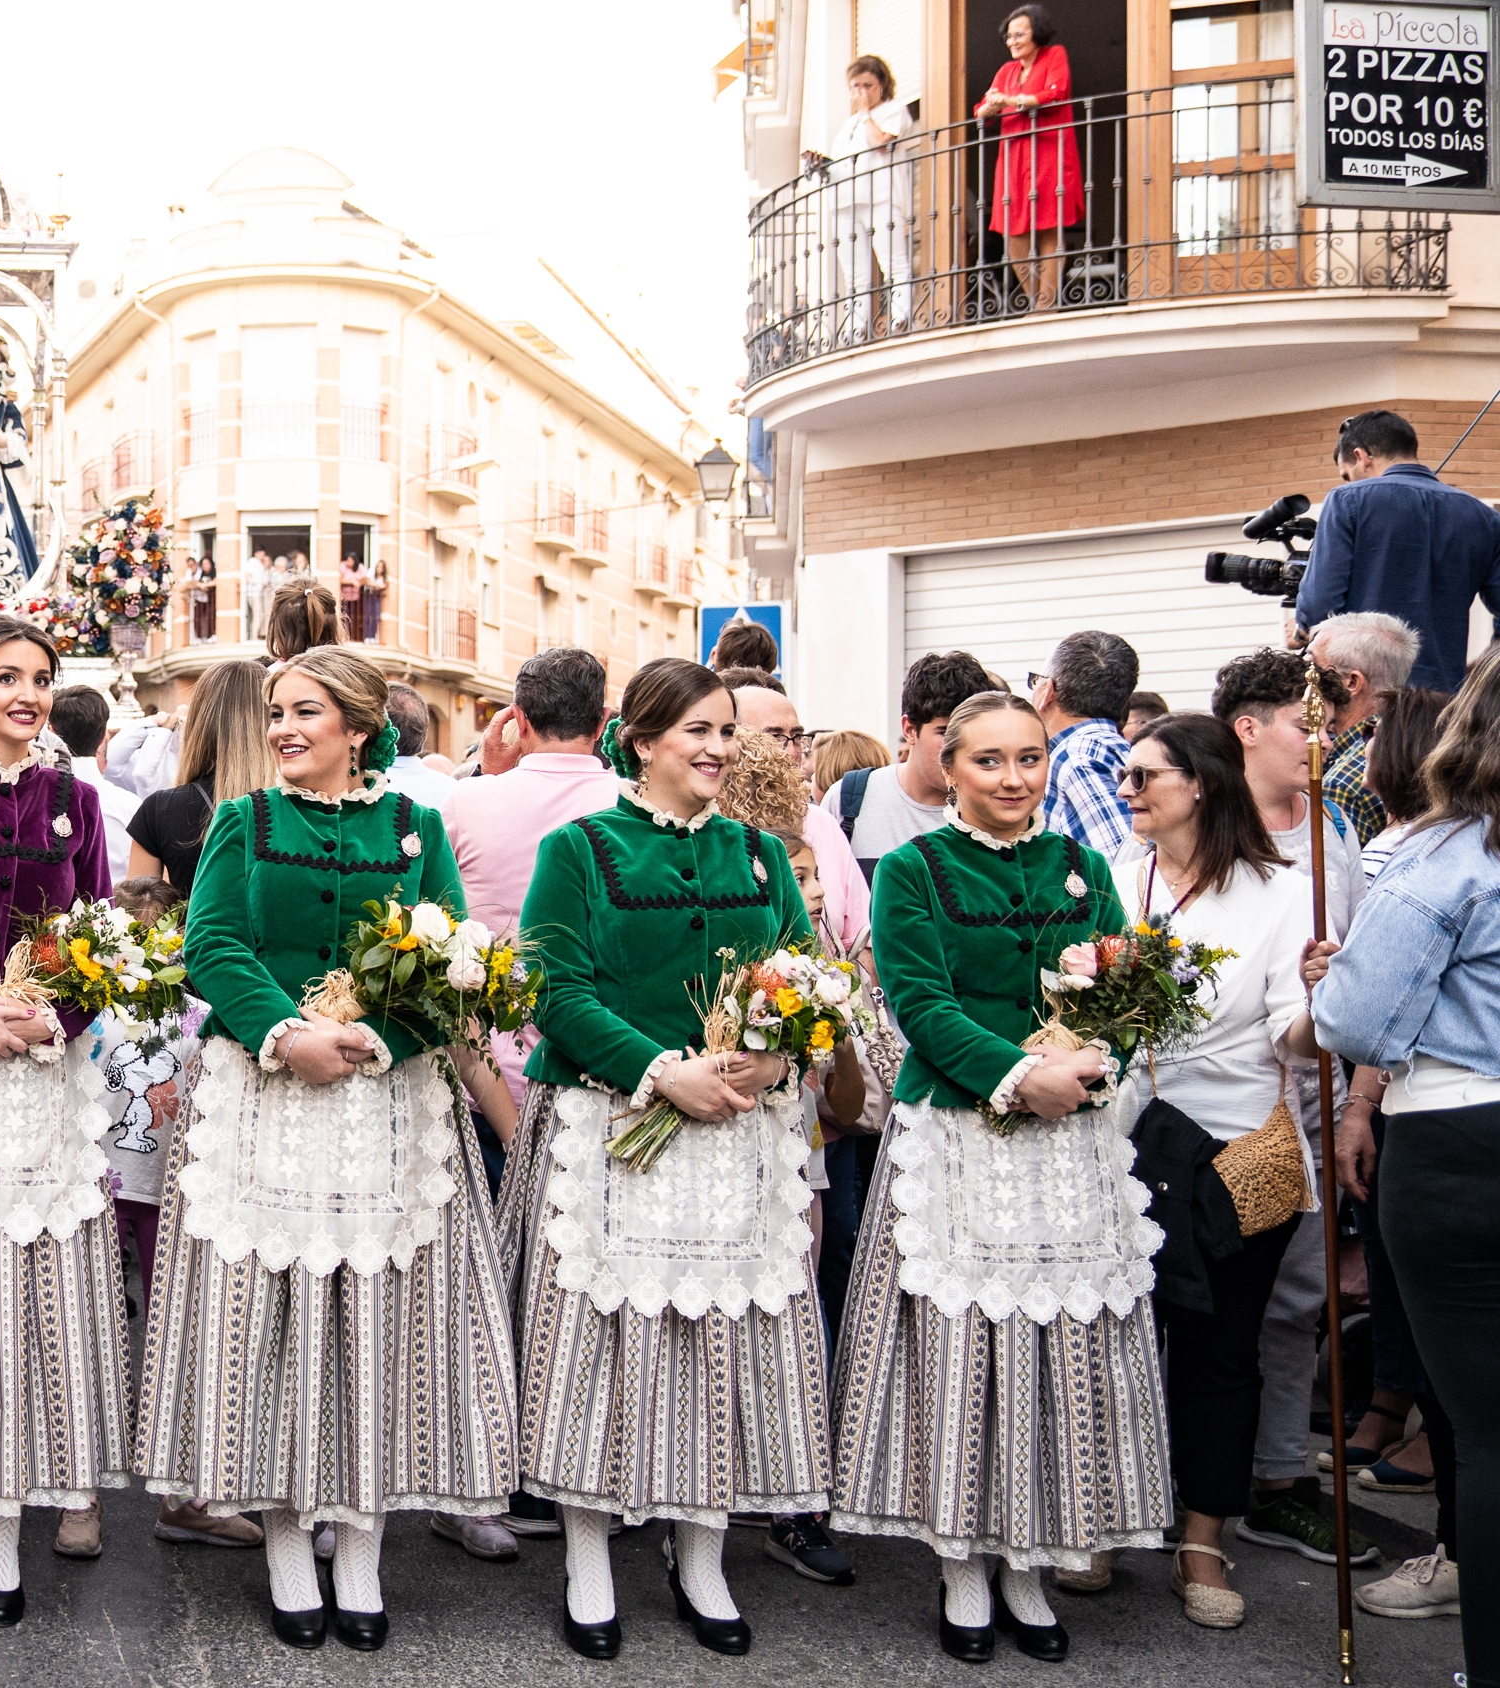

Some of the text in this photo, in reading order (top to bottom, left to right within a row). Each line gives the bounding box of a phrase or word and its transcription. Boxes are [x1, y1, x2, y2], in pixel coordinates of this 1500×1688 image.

[1331, 9, 1366, 39] La
[1327, 48, 1484, 85] 2 PIZZAS
[1328, 91, 1484, 128] POR 10 €
[1327, 128, 1485, 151] TODOS LOS DÍAS
[1349, 162, 1442, 178] A 10 METROS
